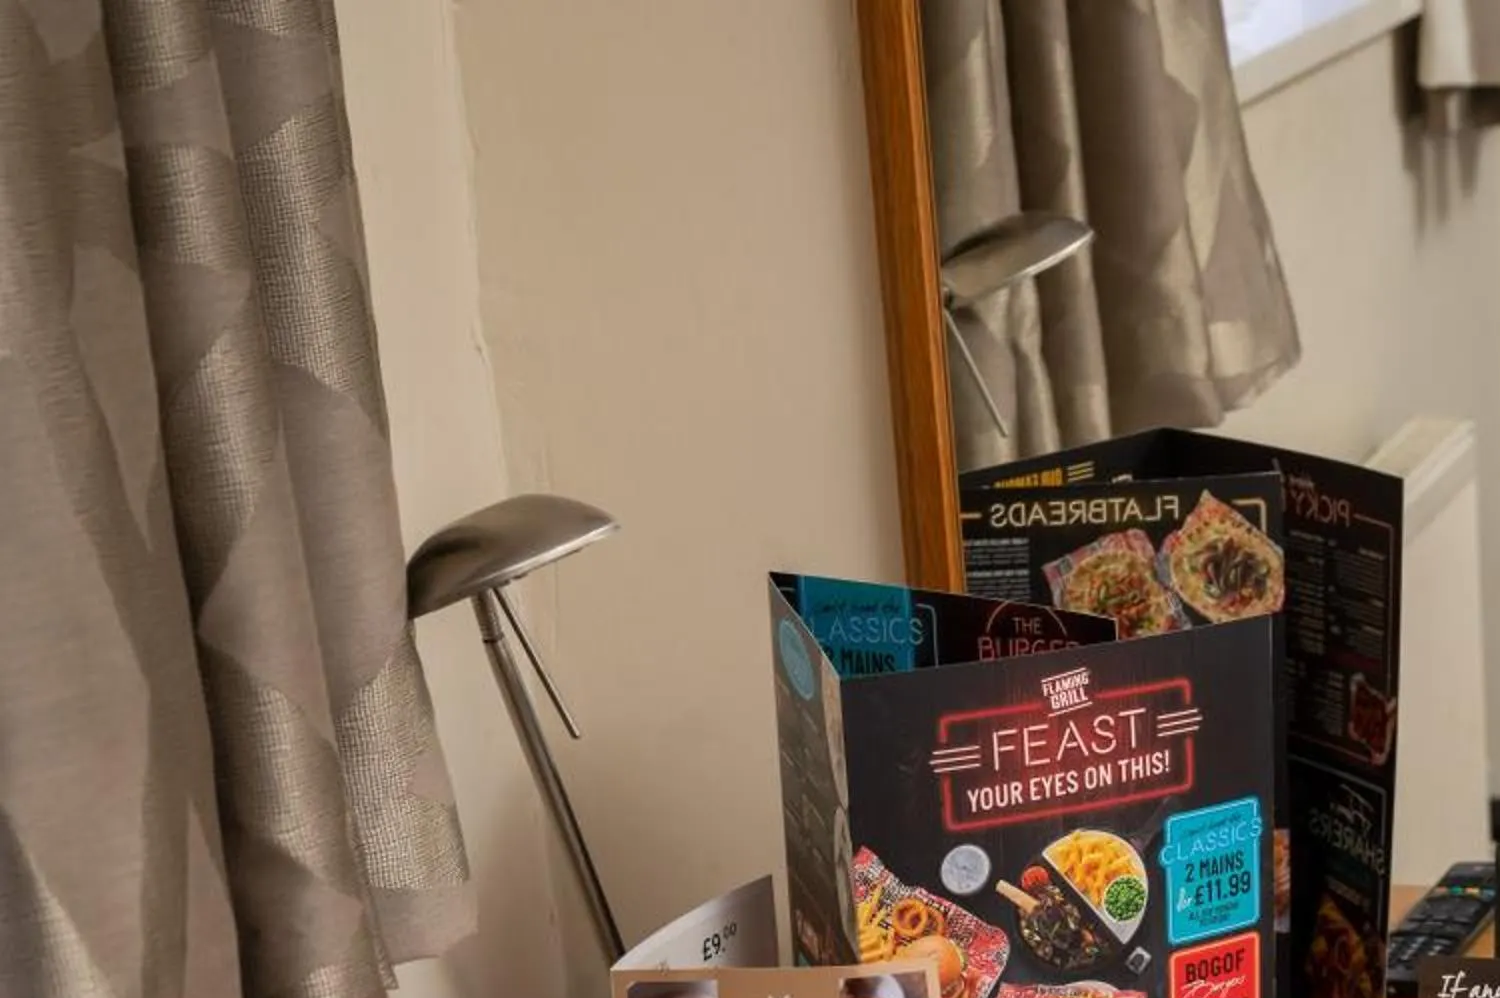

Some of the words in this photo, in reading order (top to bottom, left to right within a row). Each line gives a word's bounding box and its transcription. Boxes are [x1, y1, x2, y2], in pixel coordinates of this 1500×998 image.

[809, 615, 925, 646] LASSICS
[1012, 616, 1042, 636] THE
[840, 648, 896, 674] MAINS
[976, 636, 1080, 661] BURG
[1042, 671, 1091, 697] FLAMING
[1049, 688, 1089, 710] GRILL
[992, 707, 1147, 771] FEAST
[967, 780, 1023, 813] YOUR
[1029, 770, 1079, 801] EYES
[1084, 762, 1113, 791] ON
[1117, 749, 1171, 783] THIS!
[1159, 816, 1263, 866] CLASSICS
[1185, 863, 1195, 883] 2
[1199, 850, 1245, 879] MAINS
[1194, 870, 1252, 906] £11.99
[1184, 949, 1245, 984] BOGOF
